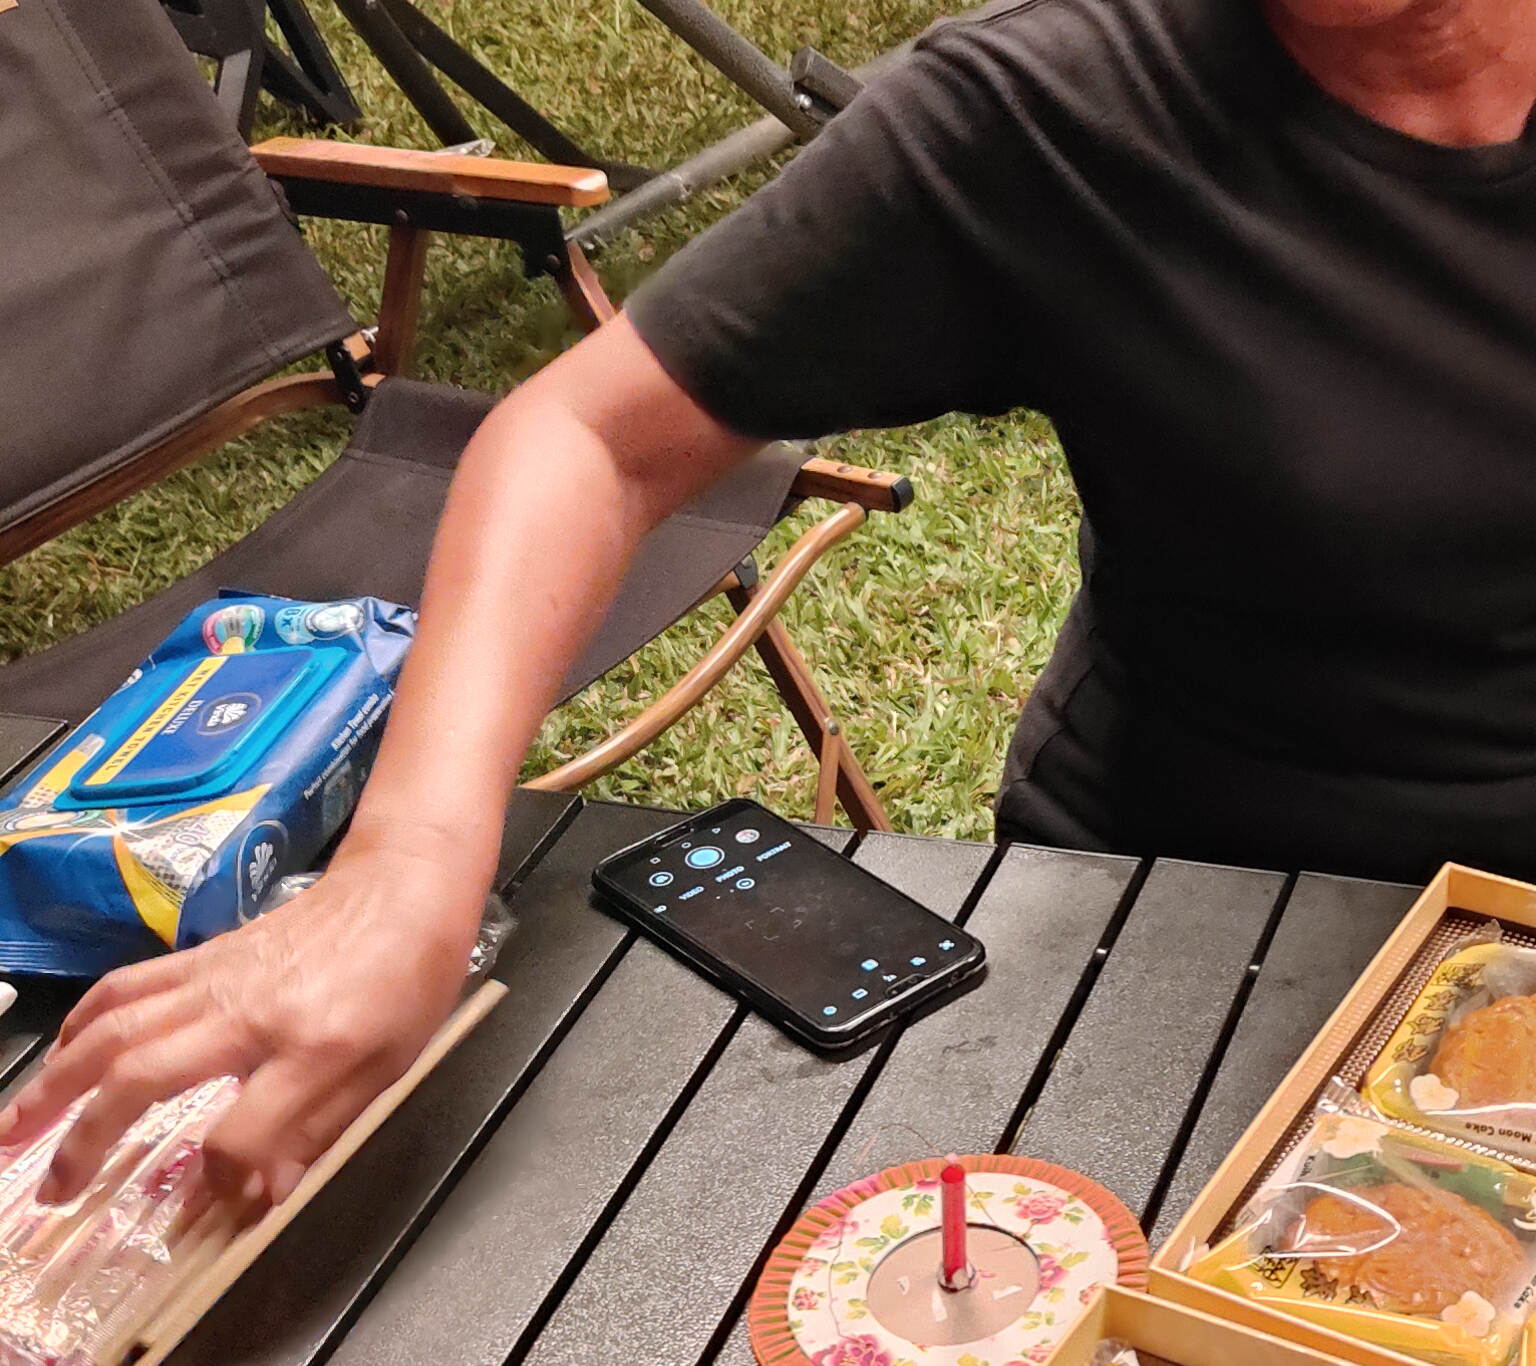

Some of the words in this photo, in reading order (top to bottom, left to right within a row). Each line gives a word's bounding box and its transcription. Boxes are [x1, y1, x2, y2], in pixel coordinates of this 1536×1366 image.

[187, 669, 211, 687] WET
[143, 691, 188, 733] KITCHEN
[160, 700, 206, 735] DELUXE
[105, 736, 146, 771] TOWEL
[755, 840, 792, 863] PORTRAIT
[715, 865, 745, 883] PHOTO
[678, 886, 705, 901] VIDEO
[1464, 1121, 1495, 1136] Cake
[1498, 1128, 1533, 1142] Moon
